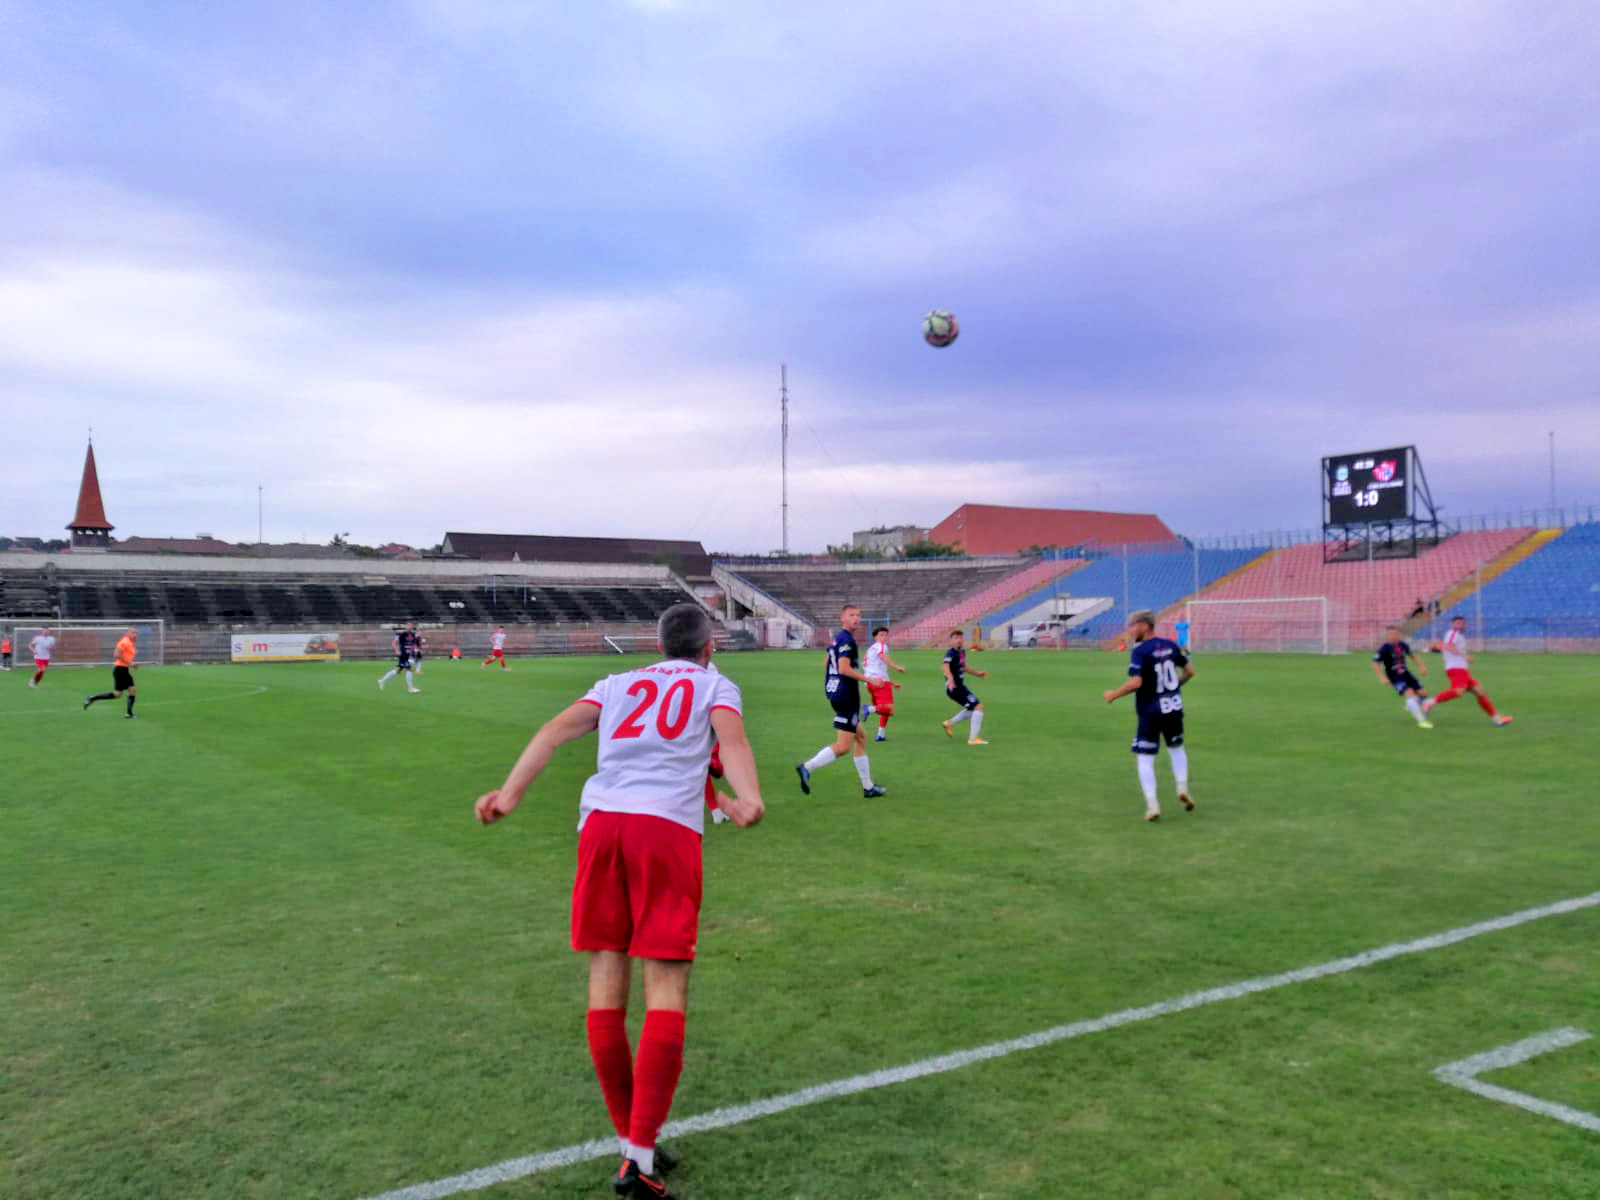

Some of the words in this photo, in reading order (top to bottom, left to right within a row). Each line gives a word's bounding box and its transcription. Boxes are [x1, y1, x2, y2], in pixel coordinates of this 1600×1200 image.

[1354, 490, 1379, 507] 1:0
[1154, 660, 1179, 693] 10
[610, 678, 695, 740] 20
